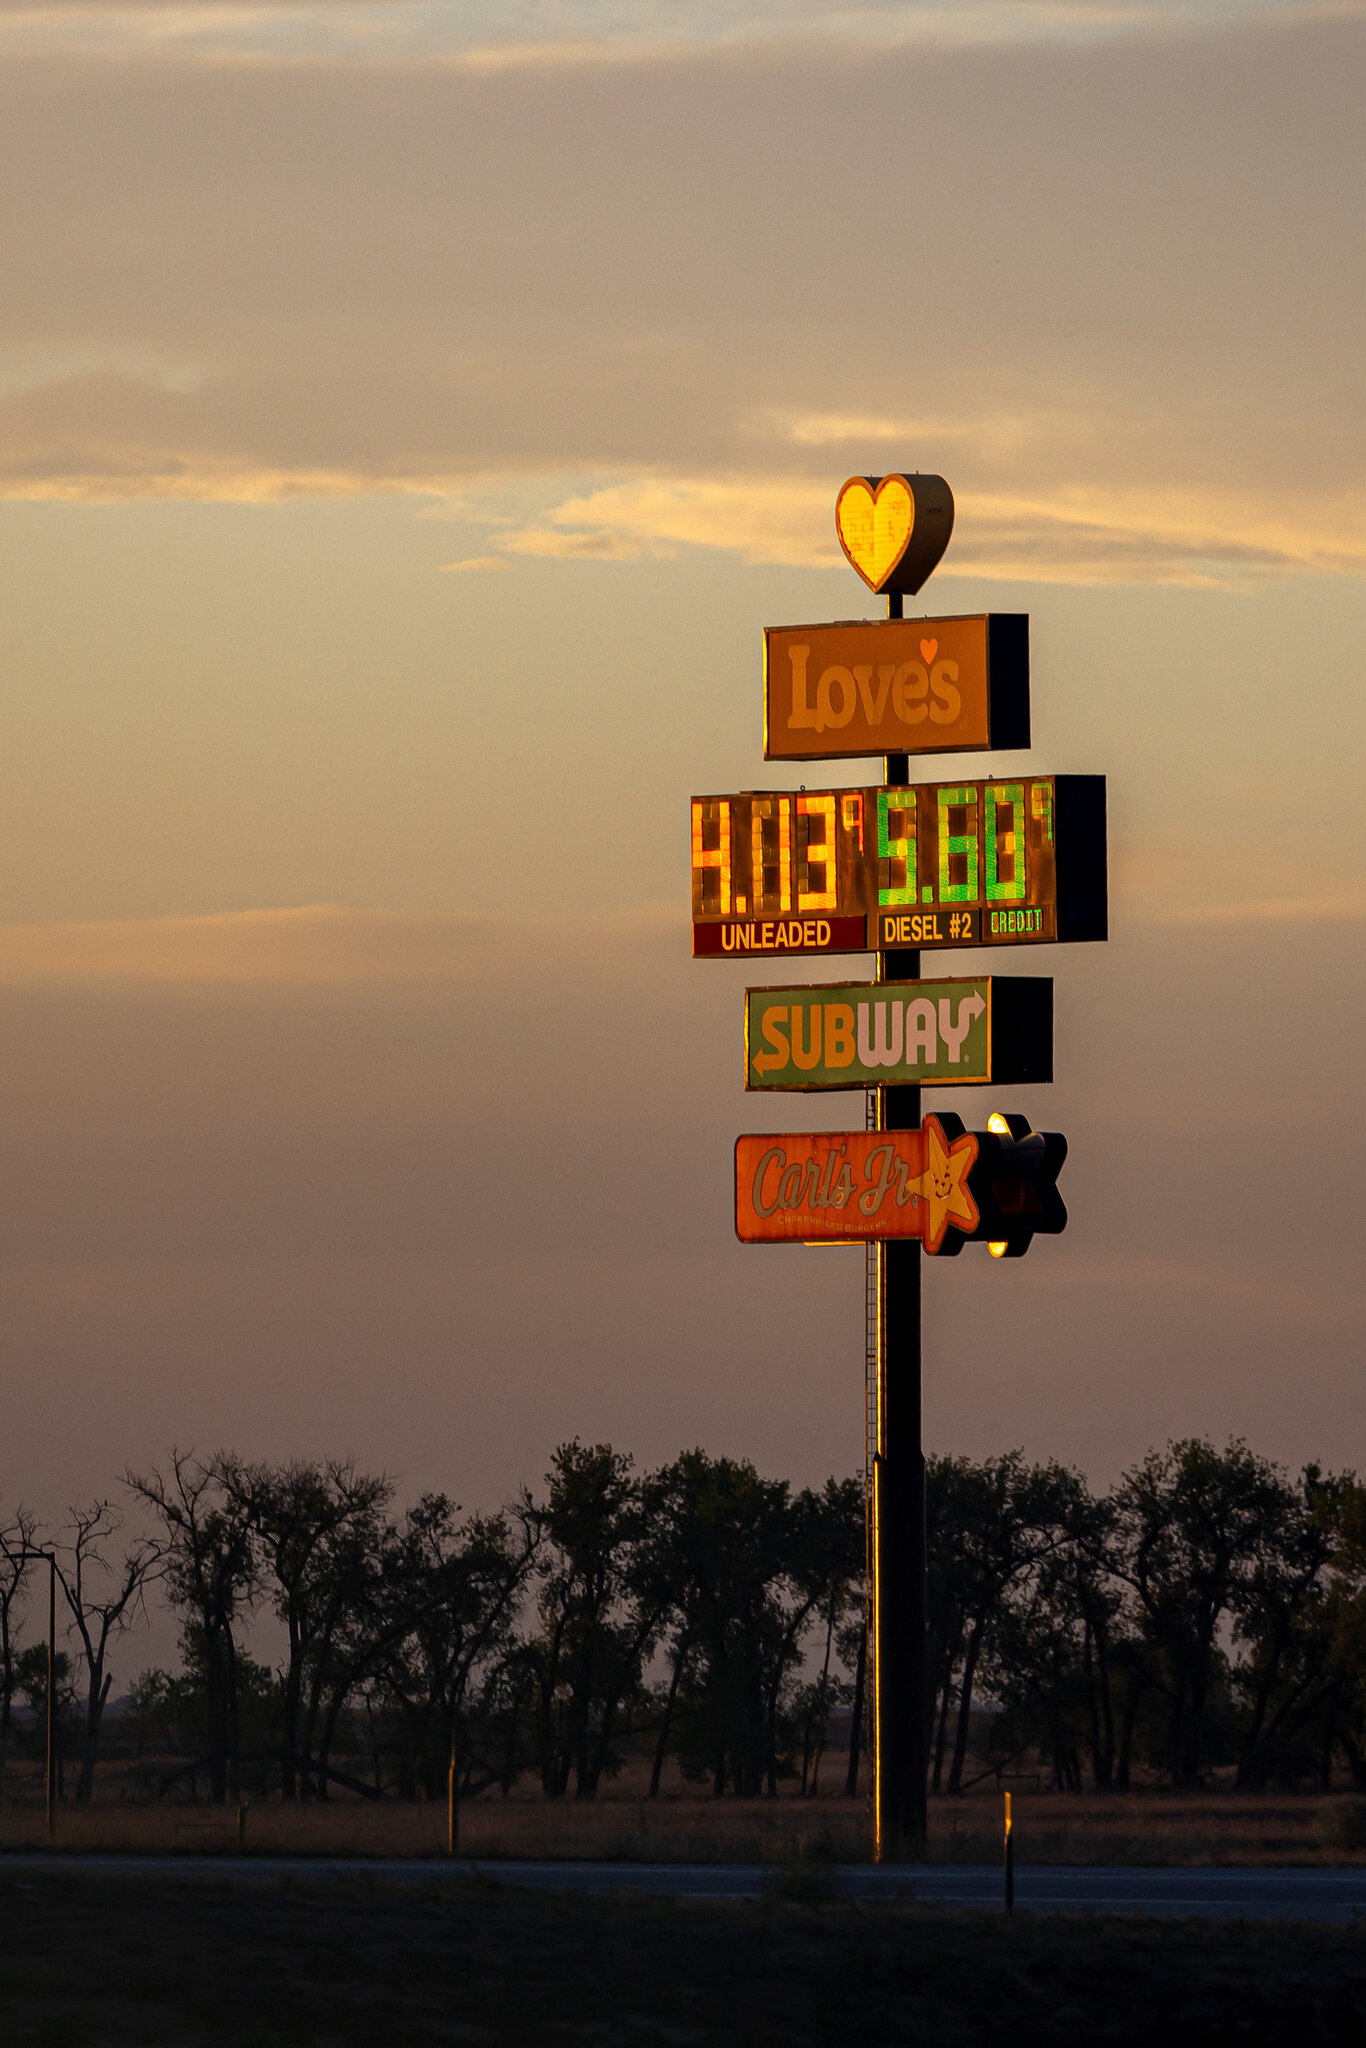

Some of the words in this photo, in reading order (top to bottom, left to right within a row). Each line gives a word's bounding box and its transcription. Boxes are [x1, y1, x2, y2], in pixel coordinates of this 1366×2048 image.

[721, 920, 831, 951] UNLEADED
[884, 915, 943, 942] DIESEL
[949, 912, 972, 939] #2
[991, 909, 1042, 933] CREDIT
[751, 989, 987, 1079] SUBWAY
[752, 1144, 858, 1218] Carl's
